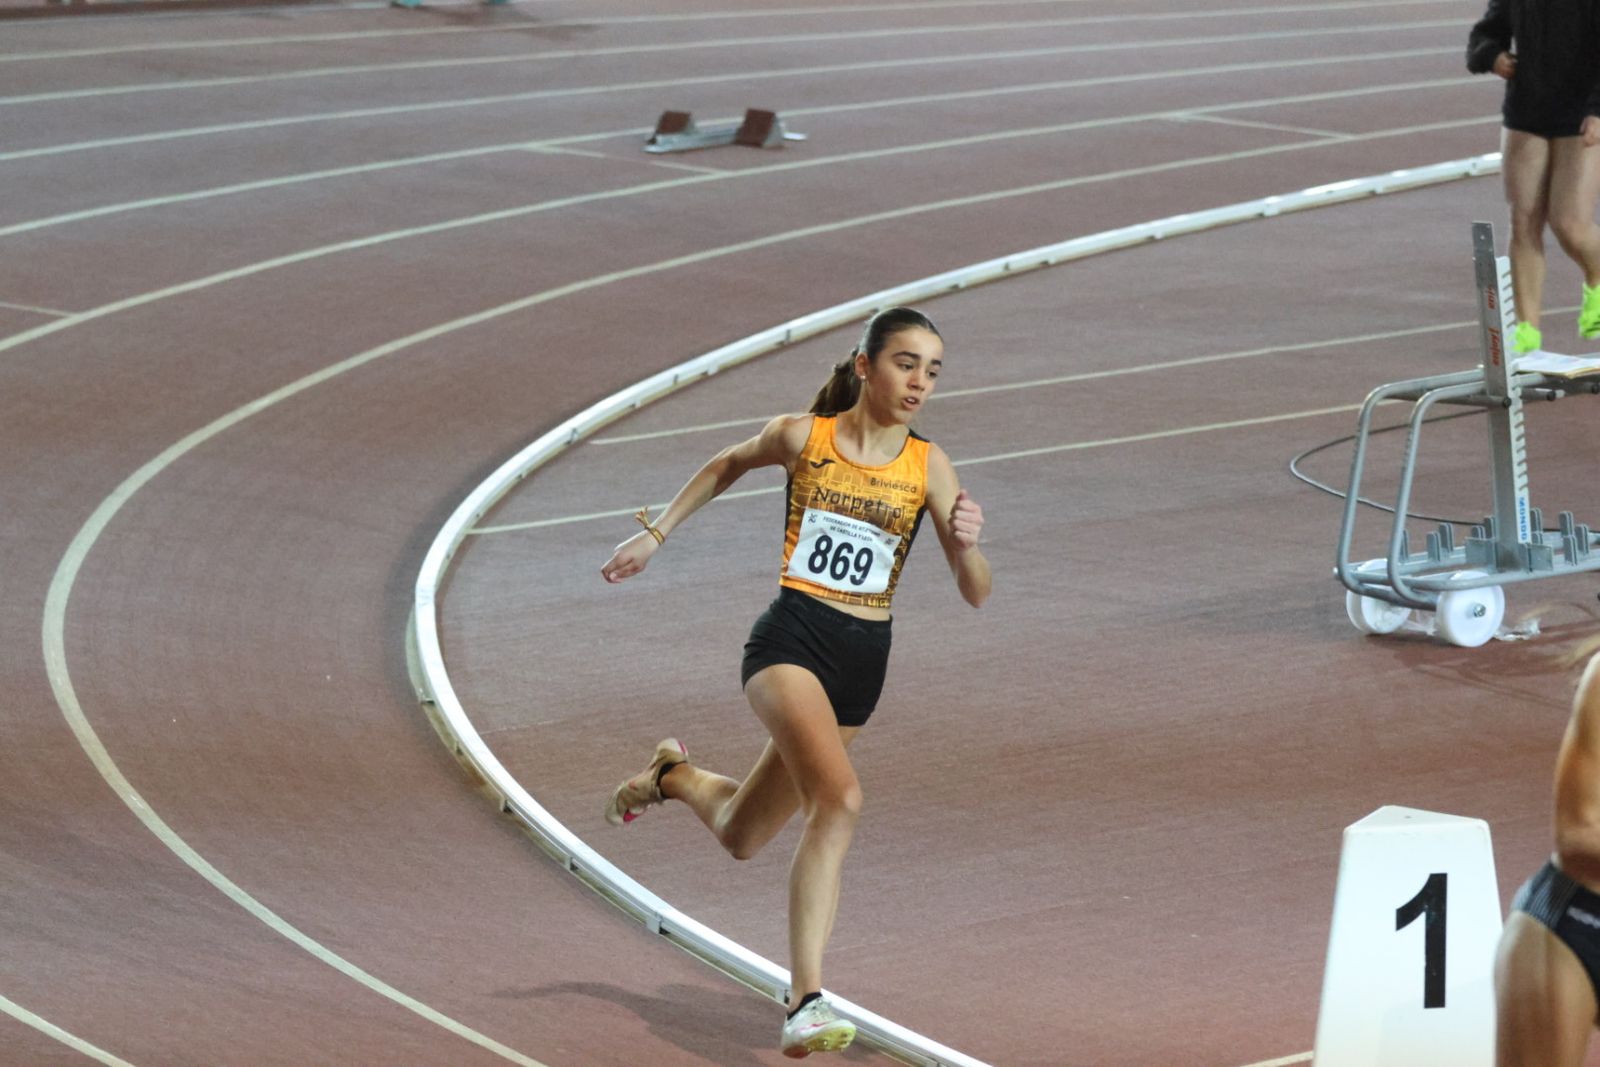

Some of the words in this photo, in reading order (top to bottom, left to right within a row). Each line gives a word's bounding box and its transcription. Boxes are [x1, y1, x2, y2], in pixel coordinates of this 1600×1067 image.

[870, 476, 917, 494] Briviesca
[1519, 496, 1528, 541] MONDO
[808, 534, 874, 586] 869
[1395, 872, 1448, 1009] 1
